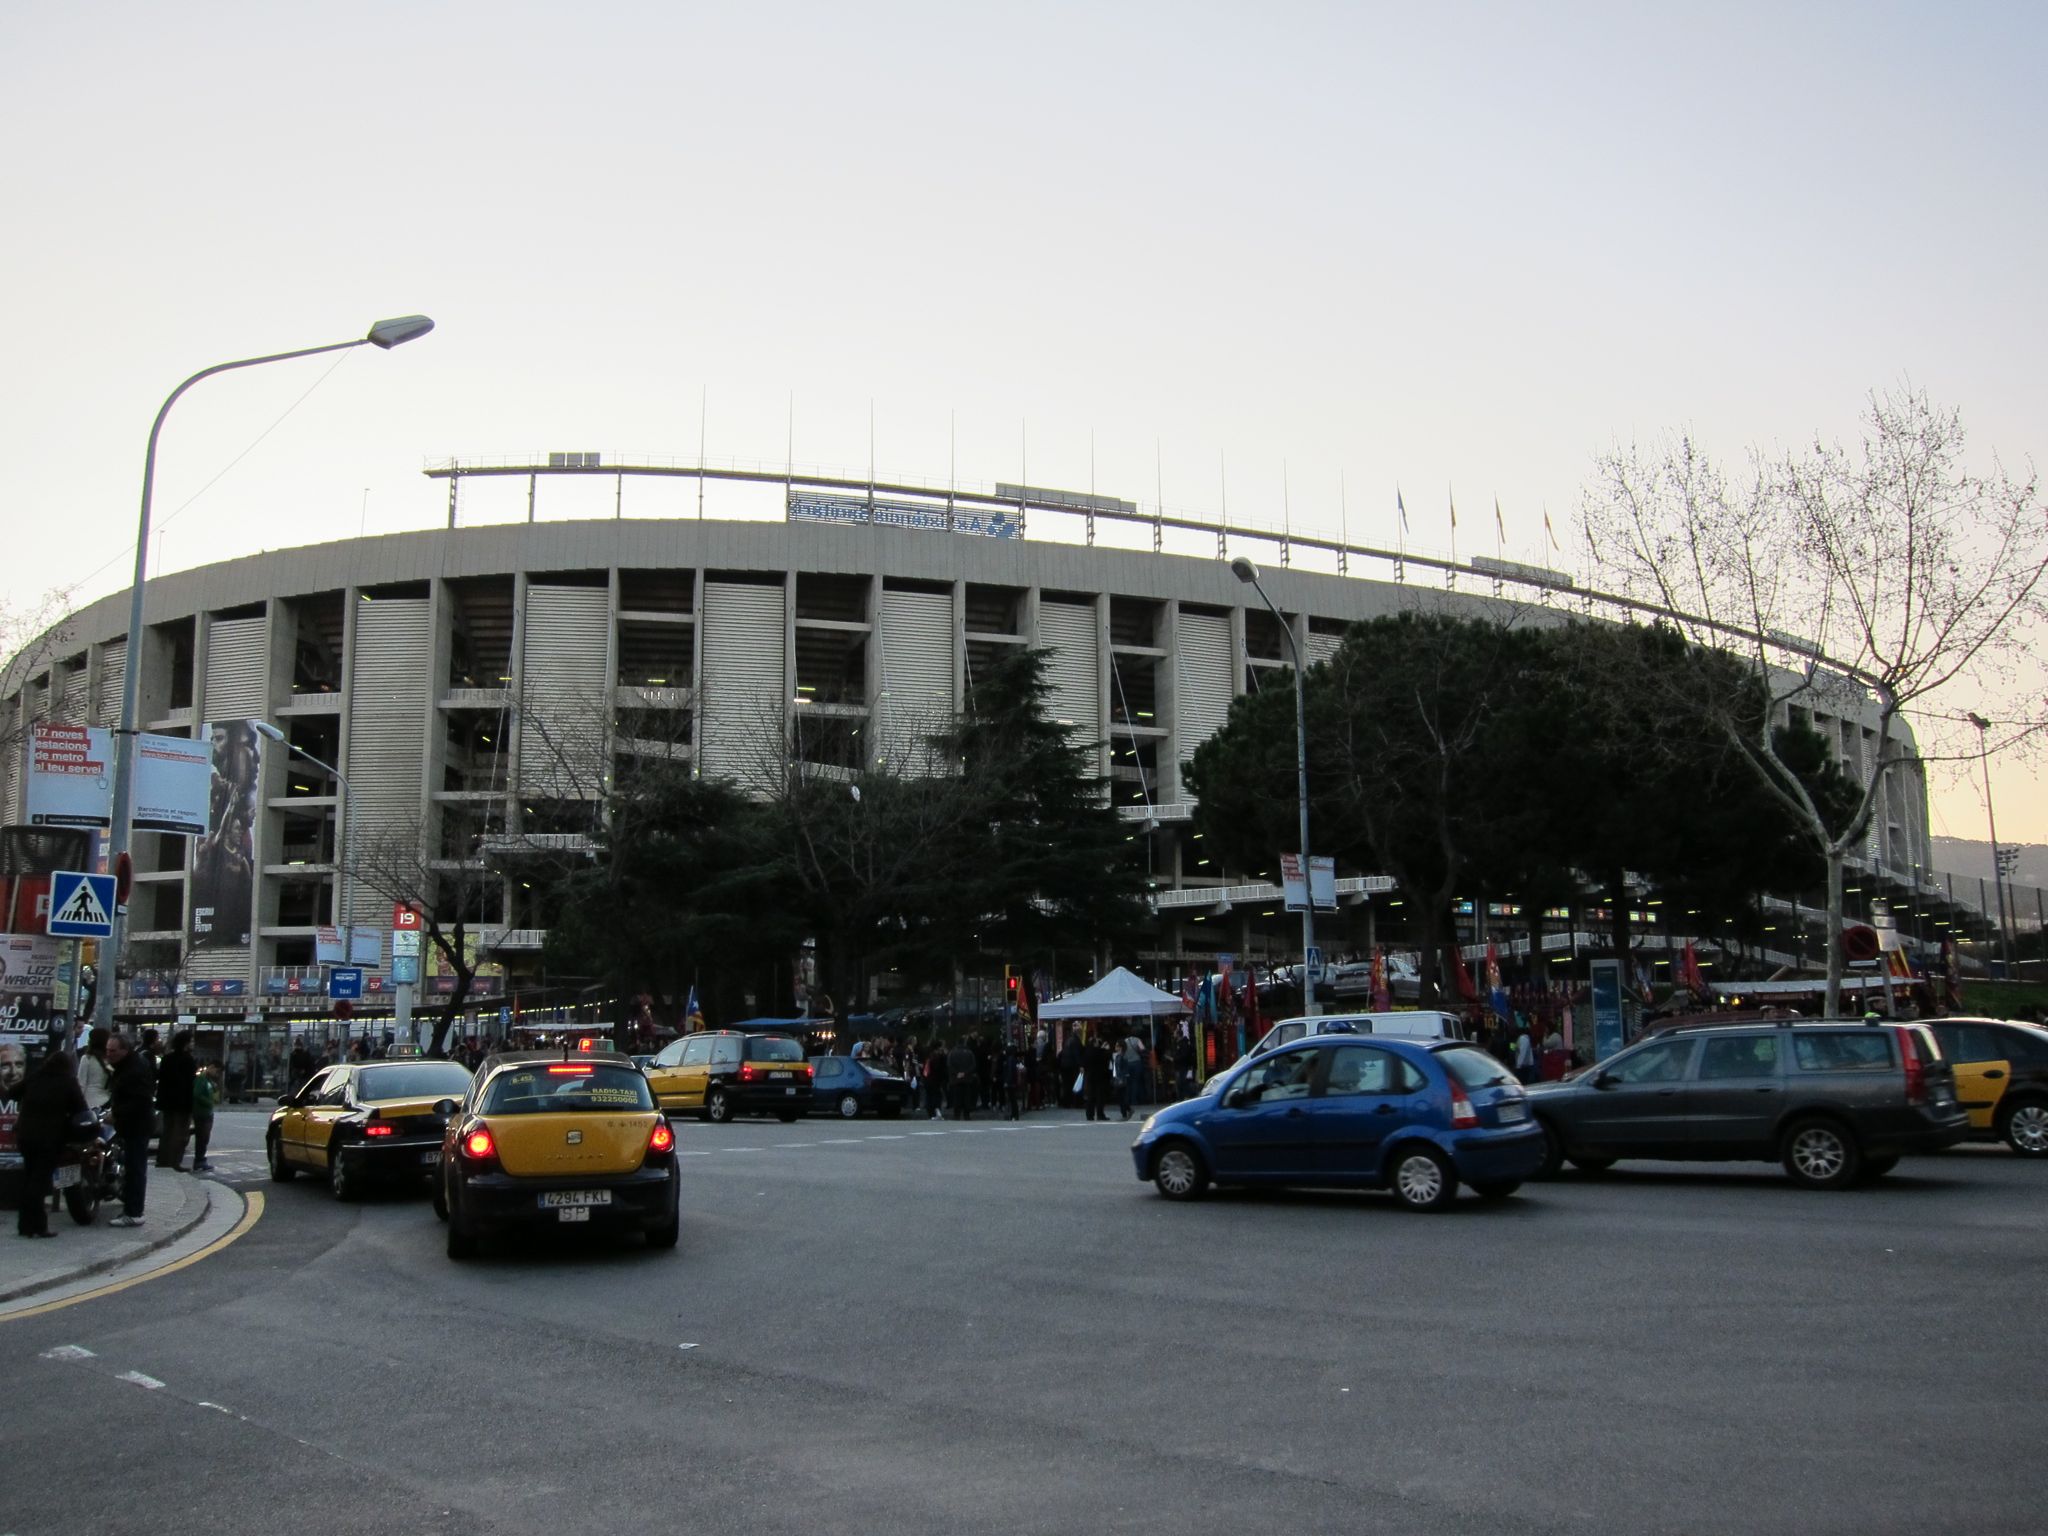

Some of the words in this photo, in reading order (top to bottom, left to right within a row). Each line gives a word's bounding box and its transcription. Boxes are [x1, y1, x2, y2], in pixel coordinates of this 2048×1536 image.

[36, 728, 48, 738] 17
[51, 730, 83, 740] noves
[35, 740, 88, 751] estacions
[35, 750, 49, 761] de
[51, 752, 84, 762] metro
[35, 762, 45, 772] al
[47, 763, 65, 772] teu
[68, 764, 102, 774] servei
[400, 913, 415, 925] 19
[27, 964, 55, 975] LIZZ
[4, 975, 55, 986] WRIGHT
[289, 983, 299, 991] 56
[339, 987, 352, 995] taxi
[0, 1005, 19, 1018] AD
[0, 1018, 50, 1032] HLDAU
[592, 1088, 638, 1096] RADIO-TAXI
[592, 1095, 639, 1104] 932250000
[547, 1192, 580, 1205] 4294
[583, 1190, 609, 1203] FKL
